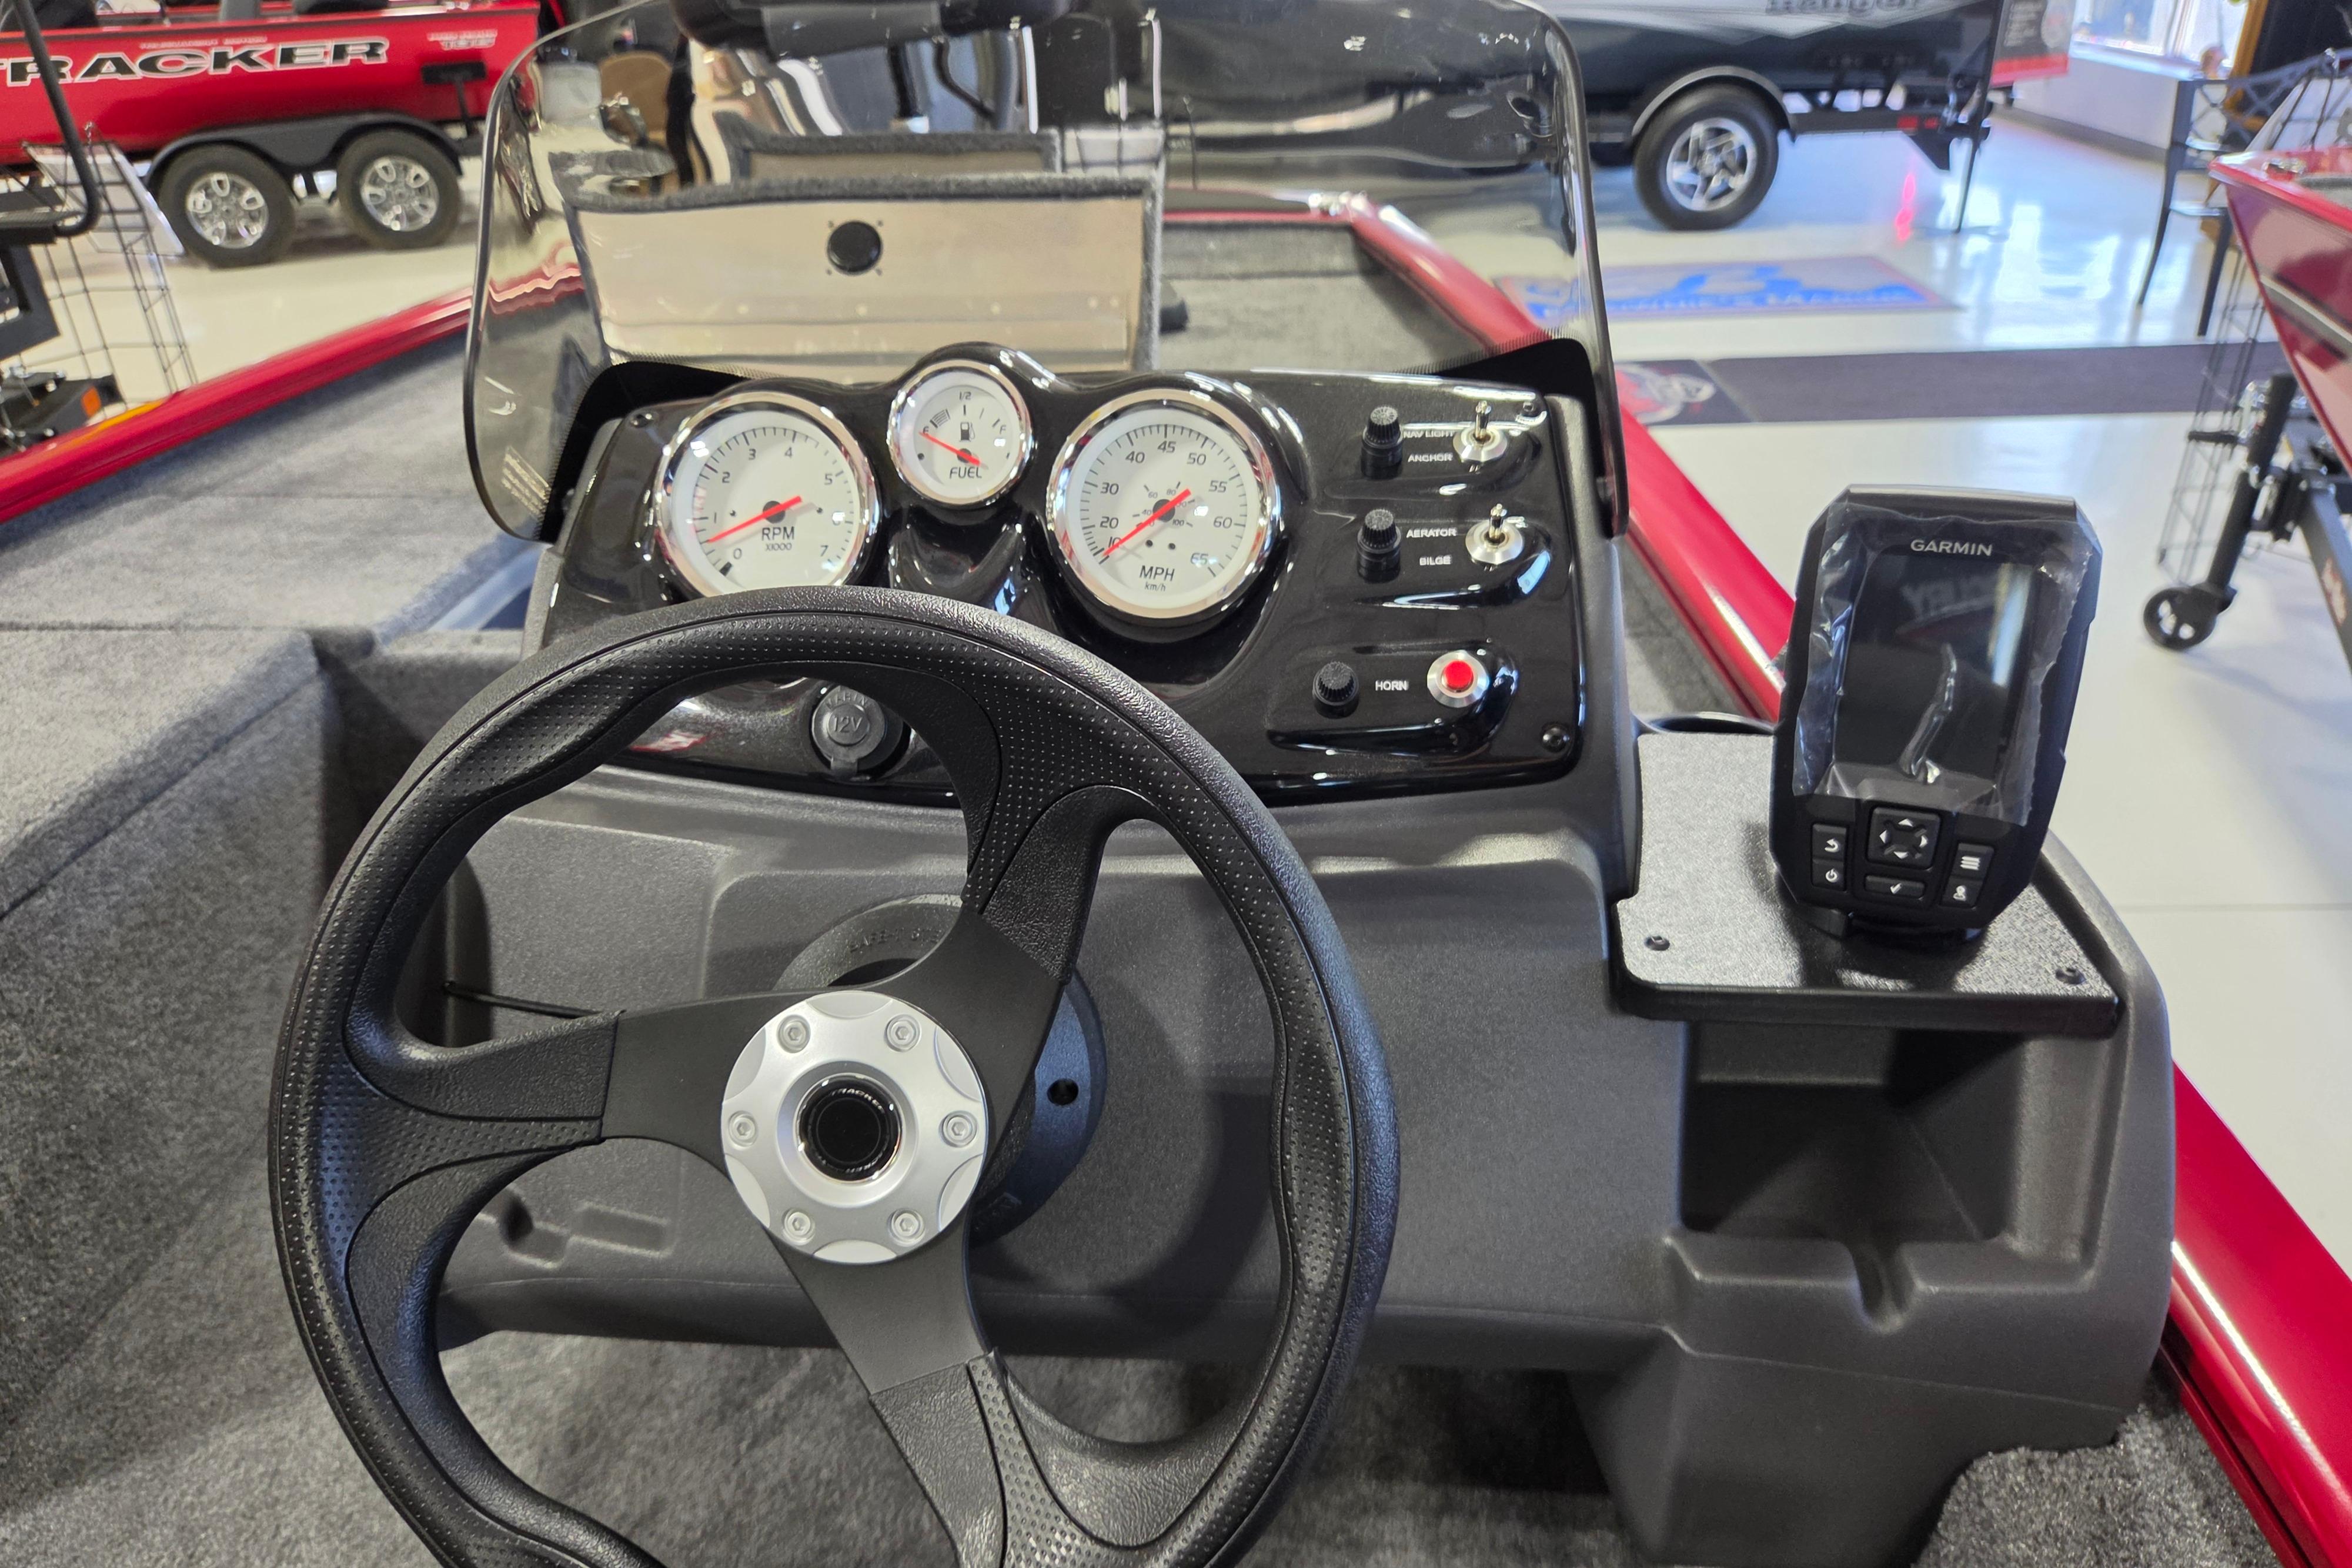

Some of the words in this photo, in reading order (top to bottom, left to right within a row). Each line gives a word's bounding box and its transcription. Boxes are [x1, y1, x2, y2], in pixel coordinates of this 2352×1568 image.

[0, 36, 389, 87] RACKER
[959, 391, 971, 400] 1/2
[1000, 425, 1007, 434] F
[784, 447, 793, 459] 4
[1157, 441, 1176, 453] 45
[748, 449, 757, 460] 3
[1125, 451, 1145, 464] 40
[1187, 453, 1207, 465] 50
[1407, 453, 1454, 463] ANCHOR
[721, 472, 731, 483] 2
[824, 473, 833, 484] 5
[949, 466, 982, 479] FUEL
[1100, 482, 1120, 495] 30
[1208, 480, 1228, 493] 55
[1100, 516, 1120, 529] 20
[1213, 516, 1232, 529] 60
[761, 526, 795, 541] RPM
[1406, 527, 1457, 538] AERATOR
[733, 548, 743, 559] 0
[820, 545, 828, 557] 7
[1910, 539, 1993, 557] GARMIN
[1190, 552, 1209, 565] 65
[1419, 555, 1452, 566] BILGE
[1139, 564, 1175, 581] MPH
[1144, 581, 1167, 592] km/h
[1375, 679, 1409, 691] HORN
[832, 716, 863, 733] 12V
